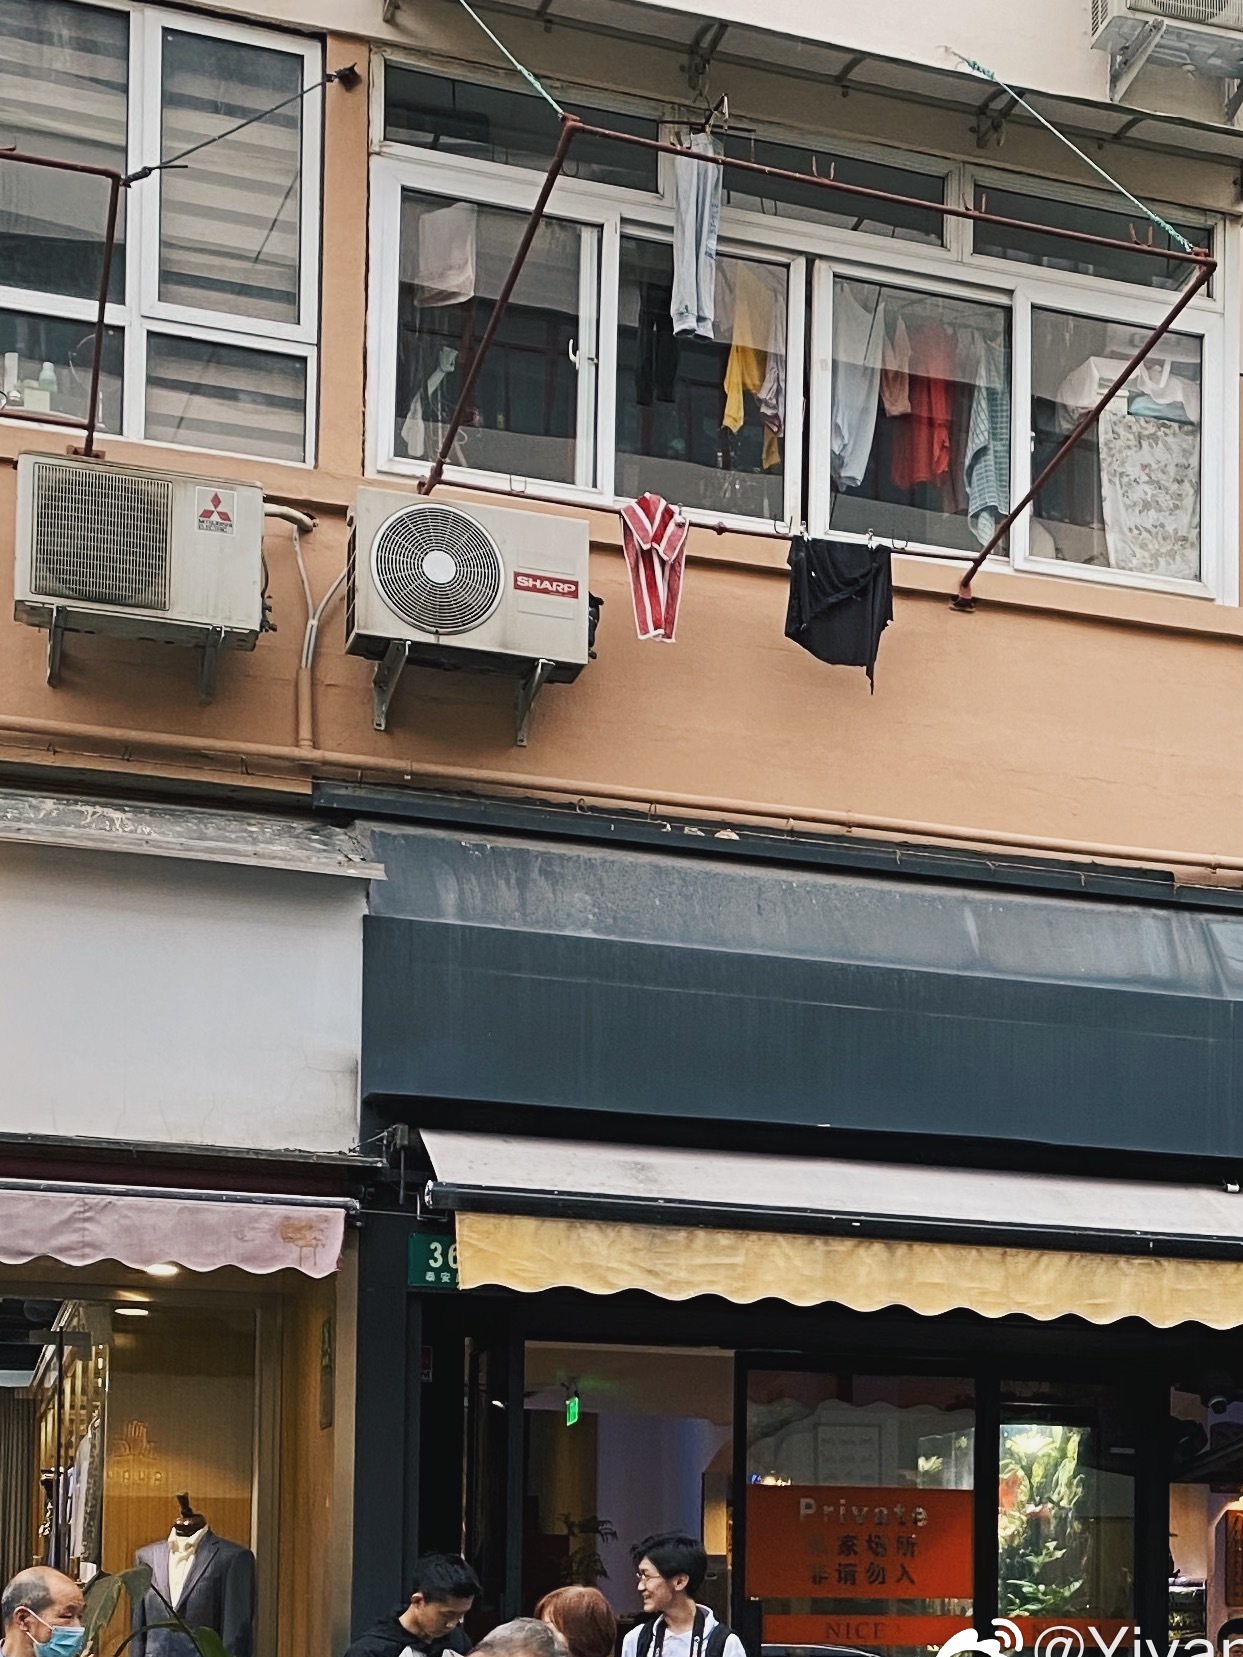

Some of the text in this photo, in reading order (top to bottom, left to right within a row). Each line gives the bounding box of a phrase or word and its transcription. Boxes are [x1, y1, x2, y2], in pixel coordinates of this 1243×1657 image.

[516, 576, 576, 593] SHARP
[799, 1497, 928, 1527] Private
[811, 1561, 916, 1585] 非请勿入
